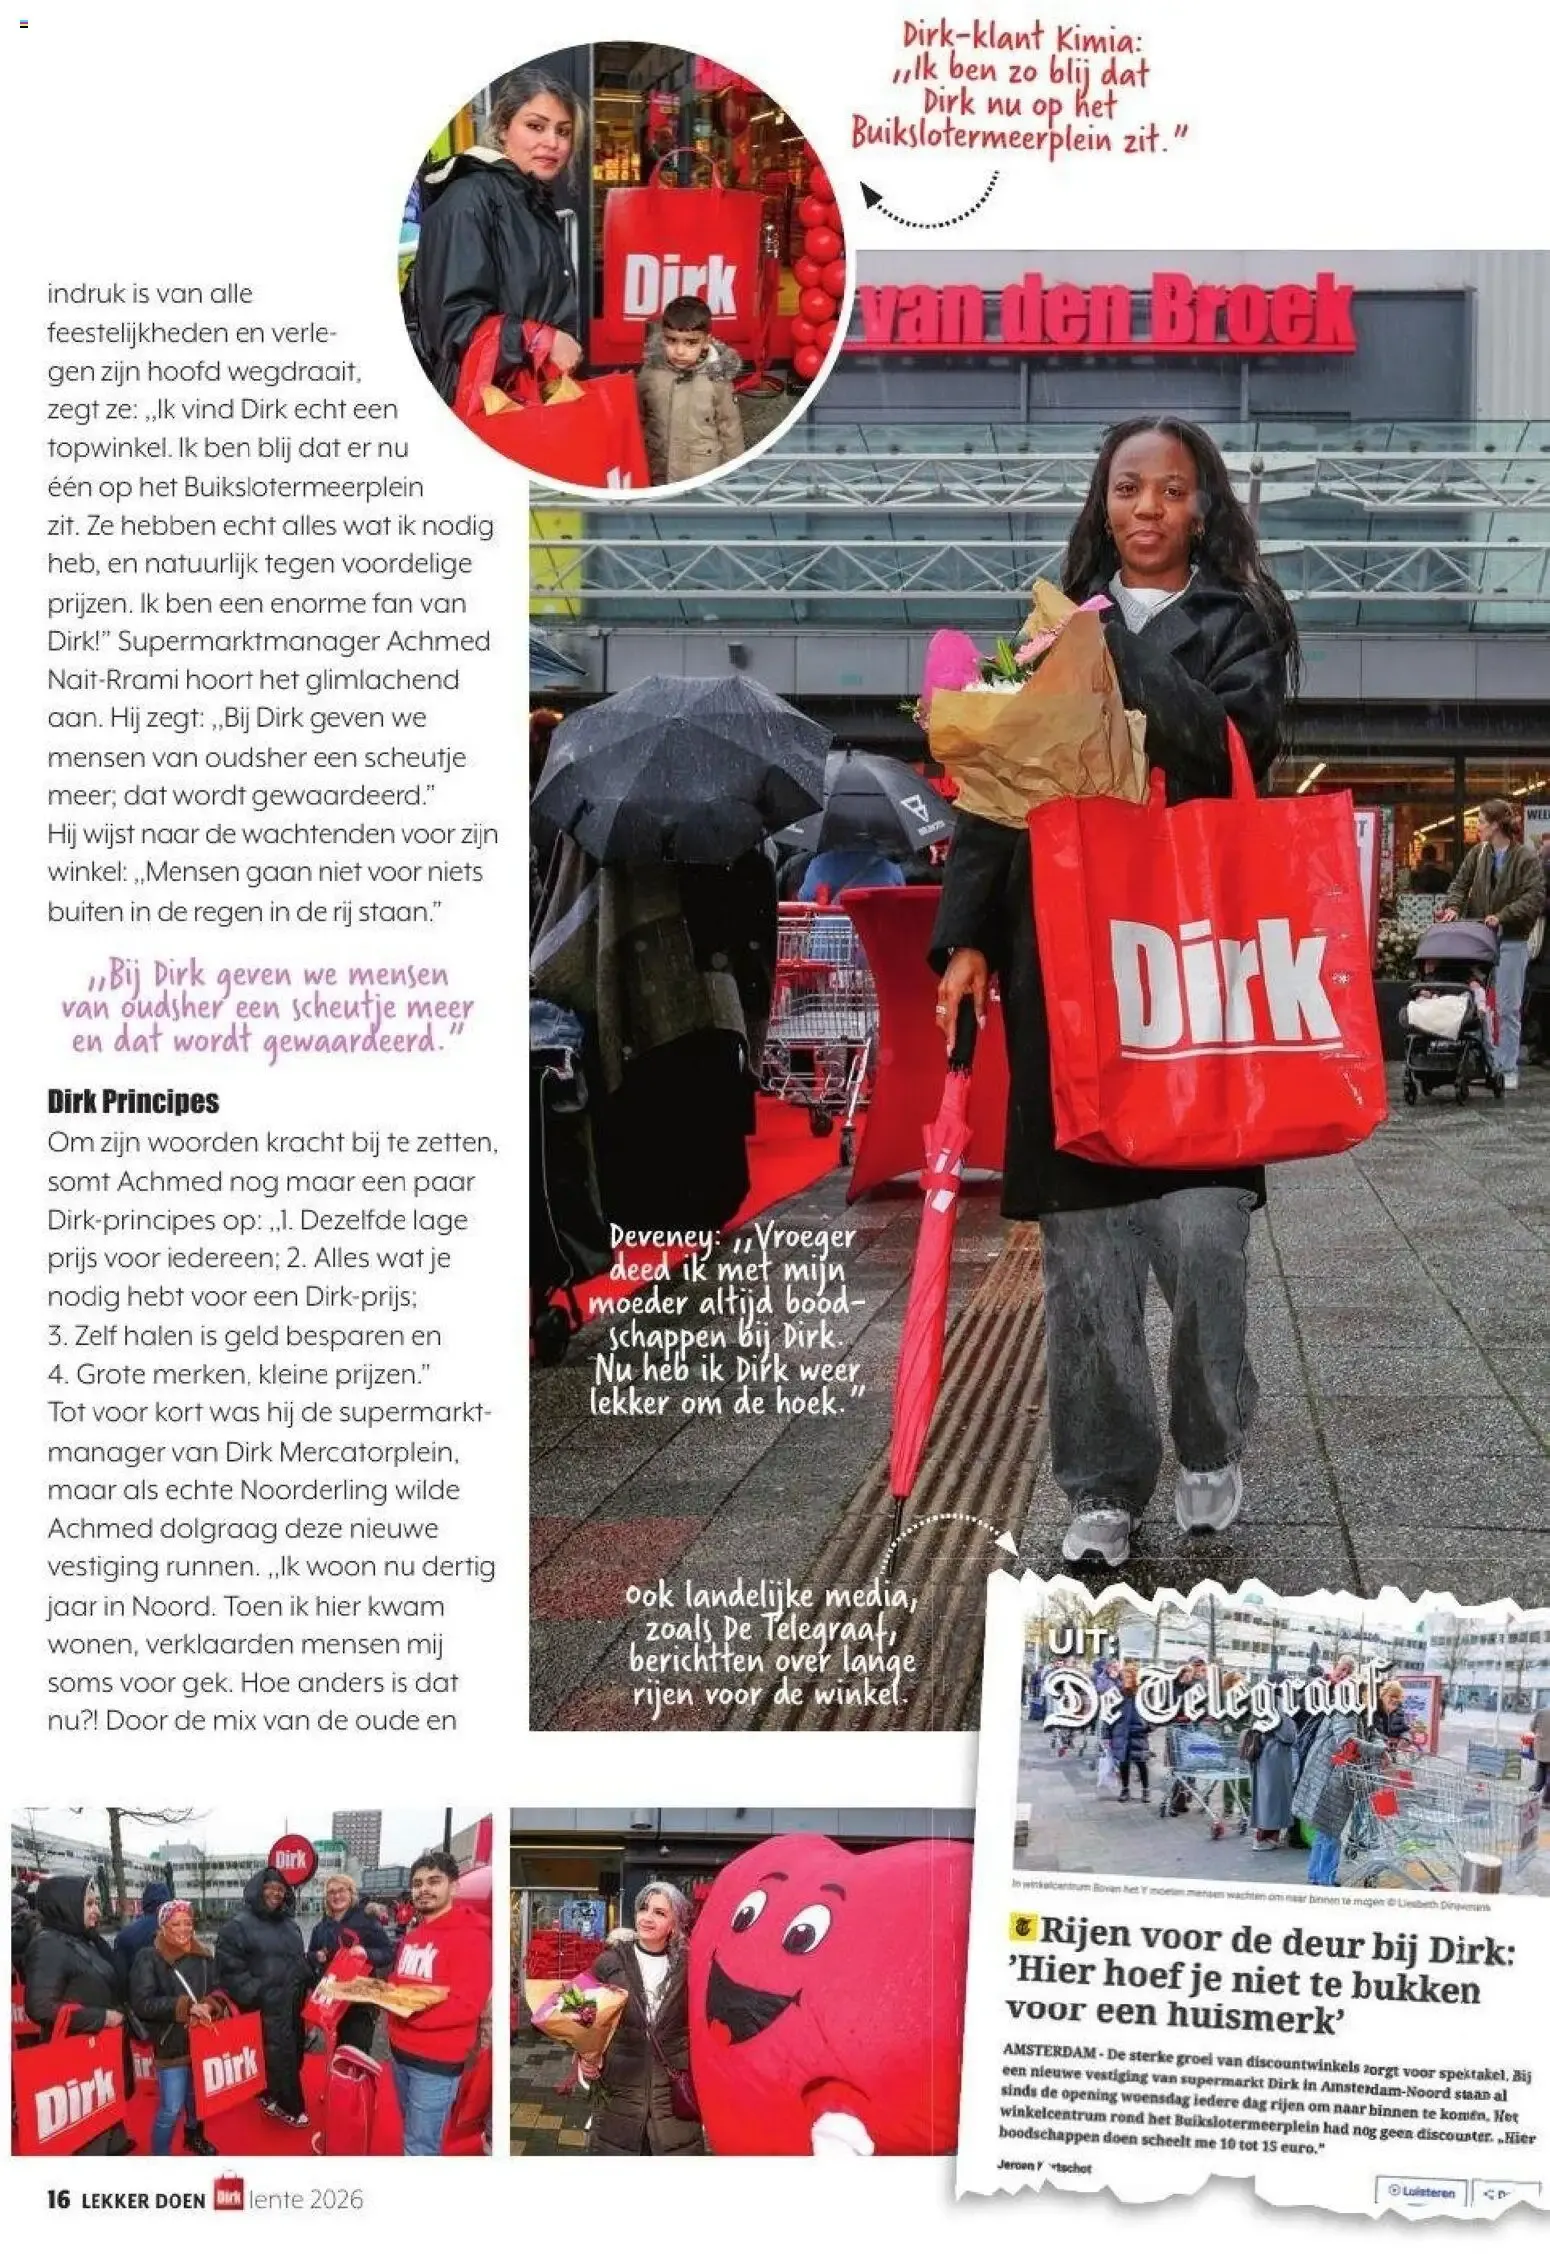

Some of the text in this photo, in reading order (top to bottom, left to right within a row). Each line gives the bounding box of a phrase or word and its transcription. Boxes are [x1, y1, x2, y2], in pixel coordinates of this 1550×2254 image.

[904, 17, 1142, 55] Dirk-klant Kimia:
[950, 48, 997, 81] ben
[1009, 65, 1038, 84] zo
[1050, 54, 1090, 96] blij
[1101, 56, 1150, 88] dat
[925, 86, 1118, 130] Dirk nu op het
[852, 113, 1111, 163] Buikslotermeerplein
[623, 253, 738, 316] Dirk
[860, 272, 1356, 346] van den Broek
[46, 321, 337, 350] feestelijkheden en verle-
[48, 475, 424, 504] één op het Buikslotermeerplein
[118, 629, 381, 658] Supermarktmanager
[386, 629, 490, 652] Achmed
[48, 668, 459, 696] Nait-Rrami hoort het glimlachend
[48, 746, 467, 774] mensen van oudsher een scheutje
[154, 957, 206, 987] Dirk
[217, 968, 291, 1000] geven
[304, 968, 337, 985] we
[349, 965, 448, 989] mensen
[1110, 918, 1342, 1050] Dirk
[62, 989, 474, 1029] van oudsher een scheutje meer
[73, 1035, 102, 1053] en
[114, 1021, 163, 1053] dat
[174, 1022, 252, 1052] wordt
[47, 1088, 220, 1117] Dirk Principes
[611, 1223, 720, 1257] Deveney:
[610, 1252, 846, 1296] deed ik met mijn
[48, 1284, 417, 1313] nodig hebt voor een Dirk-prijs;
[589, 1285, 866, 1326] moeder altijd bood-
[610, 1318, 843, 1363] schappen bij Dirk.
[596, 1353, 860, 1384] Nu heb ik Dirk weer
[591, 1386, 669, 1415] lekker
[682, 1397, 721, 1414] om
[734, 1385, 764, 1414] de
[48, 1440, 459, 1468] manager van Dirk Mercatorplein,
[47, 1517, 439, 1545] Achmed dolgraag deze nieuwe
[687, 1577, 814, 1619] landelijke
[826, 1577, 917, 1612] media,
[47, 1633, 443, 1661] wonen, verklaarden mensen mij
[647, 1610, 896, 1655] zoals De Telegraaf,
[1049, 1628, 1117, 1655] UIT:
[630, 1642, 916, 1688] berichtten over lange
[635, 1679, 907, 1720] rijen voor de winkel.
[1043, 1656, 1393, 1732] De Telegraaf
[275, 1849, 308, 1870] Dirk
[398, 1941, 439, 1980] Dirk
[1040, 1915, 1516, 1970] Rijen voor de deur bij Dirk:
[1103, 1957, 1186, 1990] hoef
[1188, 1962, 1222, 1998] je
[1231, 1965, 1301, 1996] niet
[1309, 1972, 1342, 1998] te
[1351, 1970, 1481, 2005] bukken
[1005, 1999, 1087, 2022] voor
[1096, 2003, 1157, 2026] een
[203, 2046, 259, 2095] Dirk
[1002, 2043, 1096, 2059] AMSTERDAM
[1107, 2048, 1126, 2061] De
[1129, 2050, 1174, 2063] sterke
[1217, 2056, 1243, 2068] van
[1246, 2055, 1360, 2074] discountwinkels
[1363, 2064, 1400, 2079] zorgt
[1402, 2068, 1436, 2079] voor
[1512, 2069, 1532, 2085] Bij
[35, 2066, 116, 2141] Dirk
[1000, 2104, 1107, 2122] winkelcentrum
[1110, 2112, 1145, 2125] rond
[1148, 2113, 1171, 2126] het
[1174, 2114, 1320, 2136] Buikslotermeerplein
[1323, 2121, 1350, 2136] had
[1353, 2126, 1378, 2141] nog
[1379, 2128, 1414, 2141] geen
[47, 2189, 206, 2210] 16 LEKKER DOEN
[216, 2188, 242, 2205] Dirk
[250, 2188, 364, 2210] lente 2026
[1402, 2185, 1457, 2200] Luisteren
